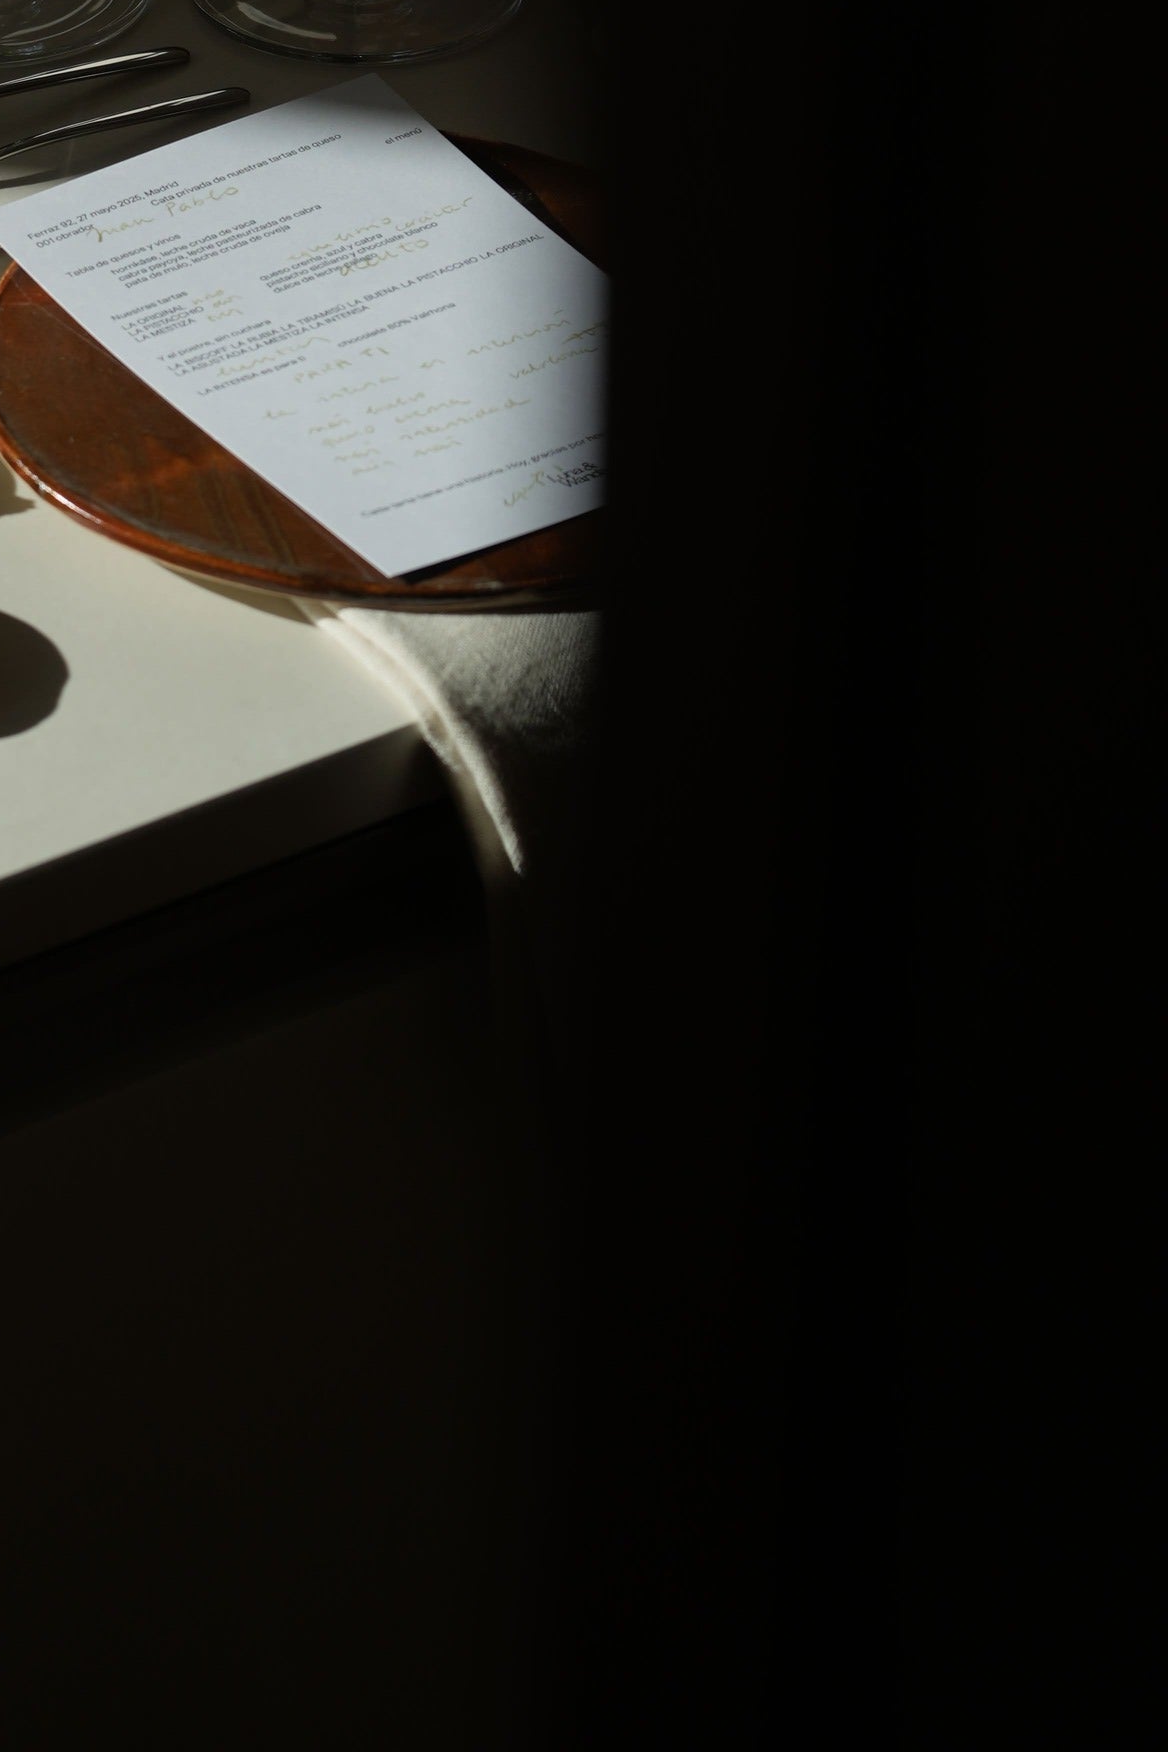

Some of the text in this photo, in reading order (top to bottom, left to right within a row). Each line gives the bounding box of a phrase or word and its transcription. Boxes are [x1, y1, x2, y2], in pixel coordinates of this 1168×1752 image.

[384, 137, 396, 145] el
[149, 134, 342, 207] Cata privada de nuestras tartas de queso
[26, 224, 61, 241] Ferraz
[75, 213, 89, 223] 27
[89, 204, 118, 218] mayo
[143, 180, 180, 198] Madrid
[35, 223, 97, 249] 001 obrador
[117, 267, 149, 282] cabra
[185, 243, 216, 257] leche
[214, 219, 282, 248] pasteurizada
[279, 215, 294, 223] de
[292, 204, 323, 218] cabra
[159, 244, 189, 258] leche
[188, 233, 219, 248] cruda
[217, 228, 233, 237] de
[231, 219, 258, 231] vaca
[265, 221, 439, 289] pistacho siciliano y chocolate blanco
[64, 233, 182, 278] Tabla de quesos y vinos
[124, 276, 149, 289] pata
[148, 271, 164, 280] de
[189, 250, 220, 264] leche
[218, 239, 250, 254] cruda
[248, 234, 263, 243] de
[262, 224, 292, 238] oveja
[259, 267, 296, 284] queso
[325, 245, 348, 258] azul
[346, 243, 354, 251] y
[353, 233, 384, 247] cabra
[269, 280, 302, 294] dulce
[300, 275, 316, 284] de
[313, 265, 344, 278] leche
[110, 291, 189, 321] Nuestras tartas
[120, 304, 187, 332] LA ORIGINAL
[126, 305, 205, 338] LA PISTACCHIO
[167, 362, 185, 372] LA
[229, 340, 247, 350] LA
[246, 329, 280, 344] RUBIA
[279, 323, 297, 332] LA
[346, 298, 364, 308] LA
[362, 285, 401, 302] BUENA
[399, 279, 417, 289] LA
[415, 256, 479, 283] PISTACCHIO
[478, 251, 496, 260] LA
[494, 233, 545, 254] ORIGINAL
[133, 317, 197, 344] LA MESTIZA
[166, 351, 178, 360] el
[213, 334, 231, 343] sin
[230, 319, 272, 337] cuchara
[173, 368, 191, 377] LA
[247, 342, 265, 352] LA
[262, 326, 311, 346] MESTIZA
[308, 321, 325, 330] LA
[323, 304, 371, 325] INTENSA
[337, 327, 388, 348] chocolate
[196, 387, 214, 397] LA
[212, 372, 261, 392] INTENSA
[259, 368, 274, 376] es
[273, 359, 299, 372] para
[568, 438, 585, 451] por
[556, 469, 607, 488] Wand
